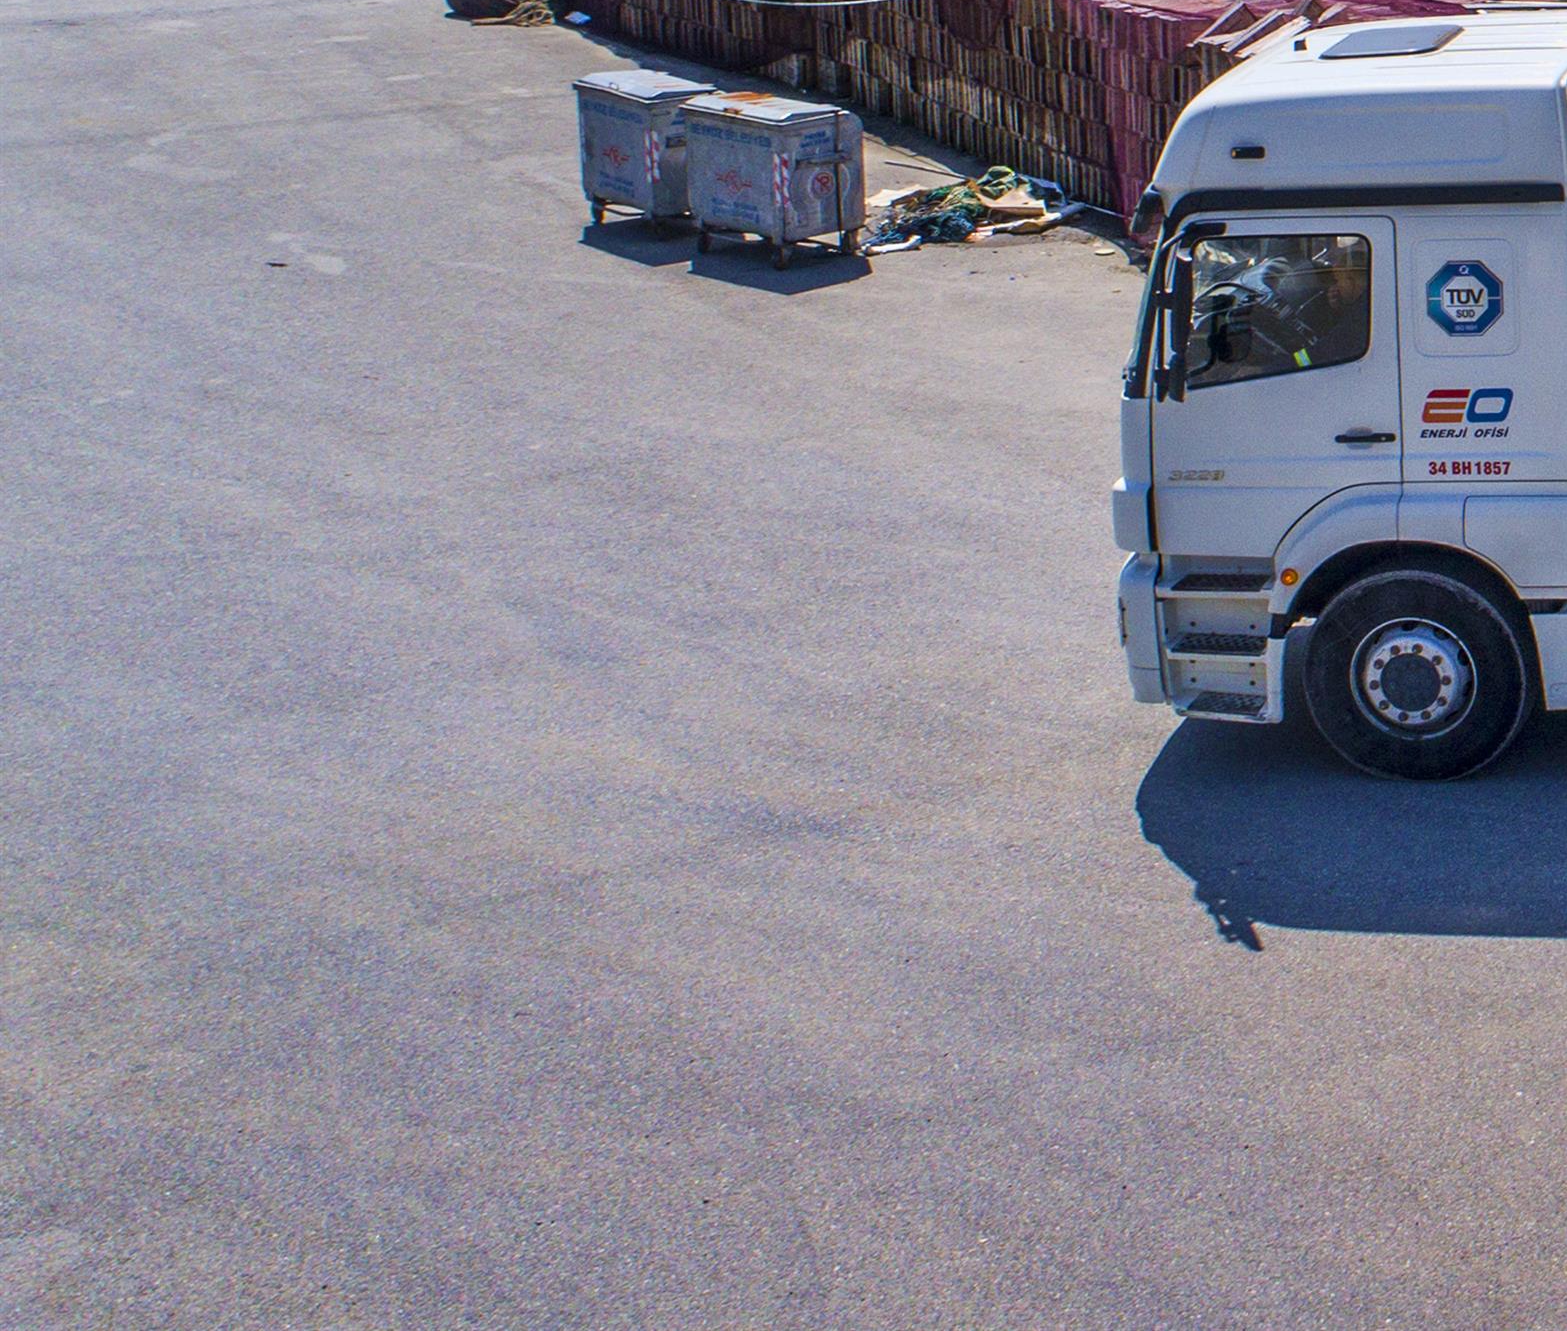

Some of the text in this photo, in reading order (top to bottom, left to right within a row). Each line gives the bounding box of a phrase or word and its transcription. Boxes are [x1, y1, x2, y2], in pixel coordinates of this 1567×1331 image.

[1422, 388, 1514, 424] EO
[1428, 460, 1512, 476] 34 BH 1857
